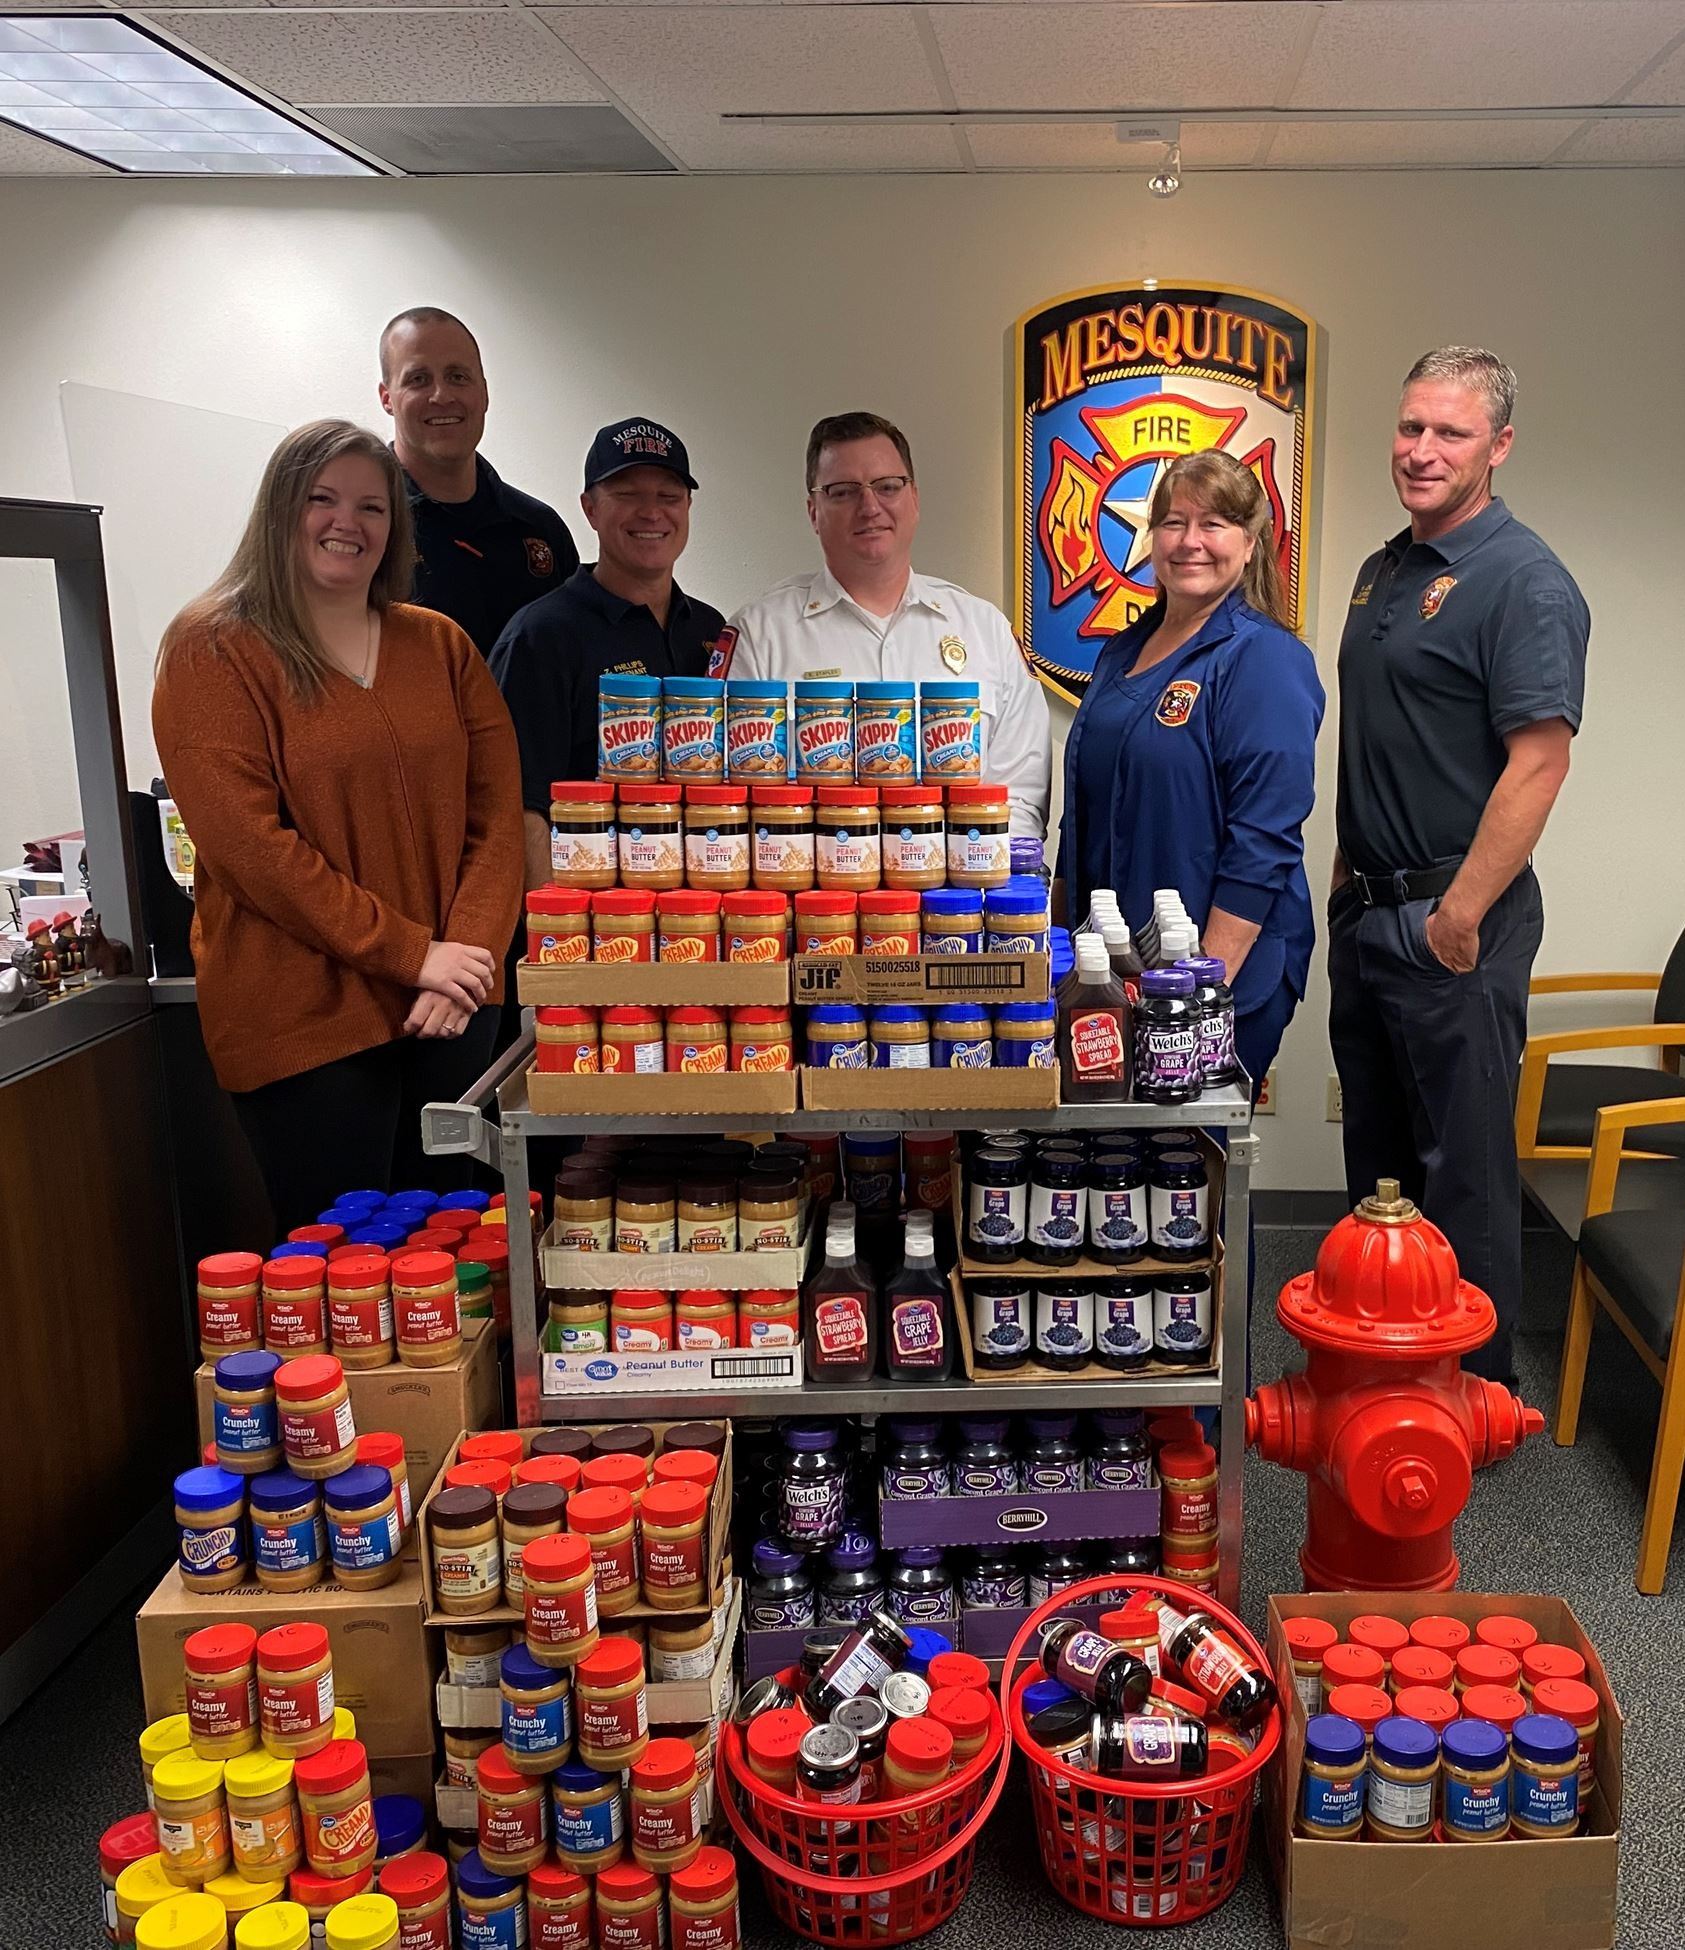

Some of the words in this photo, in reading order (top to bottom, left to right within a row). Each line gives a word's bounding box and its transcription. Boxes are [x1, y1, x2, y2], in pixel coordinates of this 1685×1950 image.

[1038, 302, 1296, 413] MESQUITE
[612, 425, 673, 448] MESQUITE
[1133, 416, 1191, 446] FIRE
[623, 437, 668, 456] FIRE
[603, 720, 655, 749] SKIPPY
[664, 720, 715, 750] SKIPPY
[800, 721, 850, 752] SKIPPY
[923, 722, 973, 752] SKIPPY
[631, 845, 657, 854] PEANUT
[706, 846, 732, 854] PEANUT
[758, 846, 782, 854] PEANUT
[836, 847, 862, 855] PEANUT
[900, 845, 926, 854] PEANUT
[967, 845, 993, 854] PEANUT
[631, 853, 657, 862] BUTTER
[706, 854, 732, 862] BUTTER
[758, 853, 783, 861] BUTTER
[836, 855, 862, 863] BUTTER
[900, 853, 926, 861] BUTTER
[967, 853, 993, 862] BUTTER
[866, 961, 921, 973] 5150025518
[800, 968, 841, 990] Jif
[1203, 1019, 1223, 1034] ch's
[1080, 1026, 1111, 1040] SQUEEZABLE
[1076, 1035, 1119, 1054] STRAWBERRY
[1151, 1033, 1193, 1050] Welch's
[1202, 1044, 1215, 1053] APE
[1088, 1049, 1113, 1062] SPREAD
[1160, 1058, 1184, 1068] GRAPE
[989, 1199, 1005, 1208] Grape
[1057, 1202, 1073, 1210] Grape
[1110, 1203, 1126, 1211] Grape
[1176, 1202, 1192, 1210] Grape
[407, 1310, 441, 1321] Creamy
[999, 1309, 1015, 1318] Grape
[1057, 1310, 1073, 1318] Grape
[1113, 1311, 1129, 1319] Grape
[1175, 1306, 1191, 1314] Grape
[206, 1312, 239, 1323] Creamy
[270, 1314, 303, 1325] Creamy
[331, 1312, 359, 1325] Creamy
[824, 1310, 856, 1323] SQUEEZABLE
[900, 1312, 931, 1325] SQUEEZABLE
[820, 1319, 862, 1336] STRAWBERRY
[904, 1322, 932, 1338] GRAPE
[623, 1340, 652, 1349] Creamy
[684, 1338, 714, 1346] Creamy
[760, 1335, 789, 1344] Creamy
[832, 1332, 857, 1345] SPREAD
[912, 1335, 928, 1347] JELLY
[588, 1364, 612, 1373] Great
[626, 1361, 667, 1370] Peanut
[671, 1360, 704, 1369] Butter
[222, 1416, 260, 1428] Crunchy
[284, 1424, 316, 1437] Creamy
[788, 1489, 829, 1505] Welch's
[1181, 1503, 1210, 1515] Creamy
[795, 1512, 819, 1522] GRAPE
[1002, 1512, 1042, 1525] BERRYHILL
[186, 1529, 231, 1561] CRUNCHY
[260, 1537, 297, 1550] Crunchy
[335, 1535, 371, 1546] Crunchy
[593, 1559, 617, 1571] eamy
[650, 1553, 684, 1565] Creamy
[531, 1607, 566, 1620] Creamy
[901, 1612, 928, 1622] Concord
[928, 1612, 947, 1622] Grape
[1077, 1636, 1101, 1658] GRAPE
[1091, 1644, 1104, 1656] JELLY
[1217, 1660, 1230, 1676] JELLY
[191, 1699, 226, 1713] Creamy
[263, 1698, 296, 1710] Creamy
[508, 1715, 545, 1728] Crunchy
[584, 1713, 618, 1726] Creamy
[1143, 1723, 1159, 1750] GRAPE
[1322, 1790, 1358, 1803] Crunchy
[1529, 1789, 1567, 1801] Crunchy
[1463, 1796, 1500, 1807] Crunchy
[324, 1803, 370, 1848] CREAMY
[487, 1817, 522, 1830] Creamy
[557, 1815, 592, 1830] Crunchy
[638, 1815, 673, 1830] Creamy
[461, 1920, 496, 1936] Crunchy
[542, 1921, 578, 1935] Creamy
[605, 1926, 638, 1940] Creamy
[686, 1925, 722, 1938] Creamy
[401, 1928, 432, 1946] reamy
